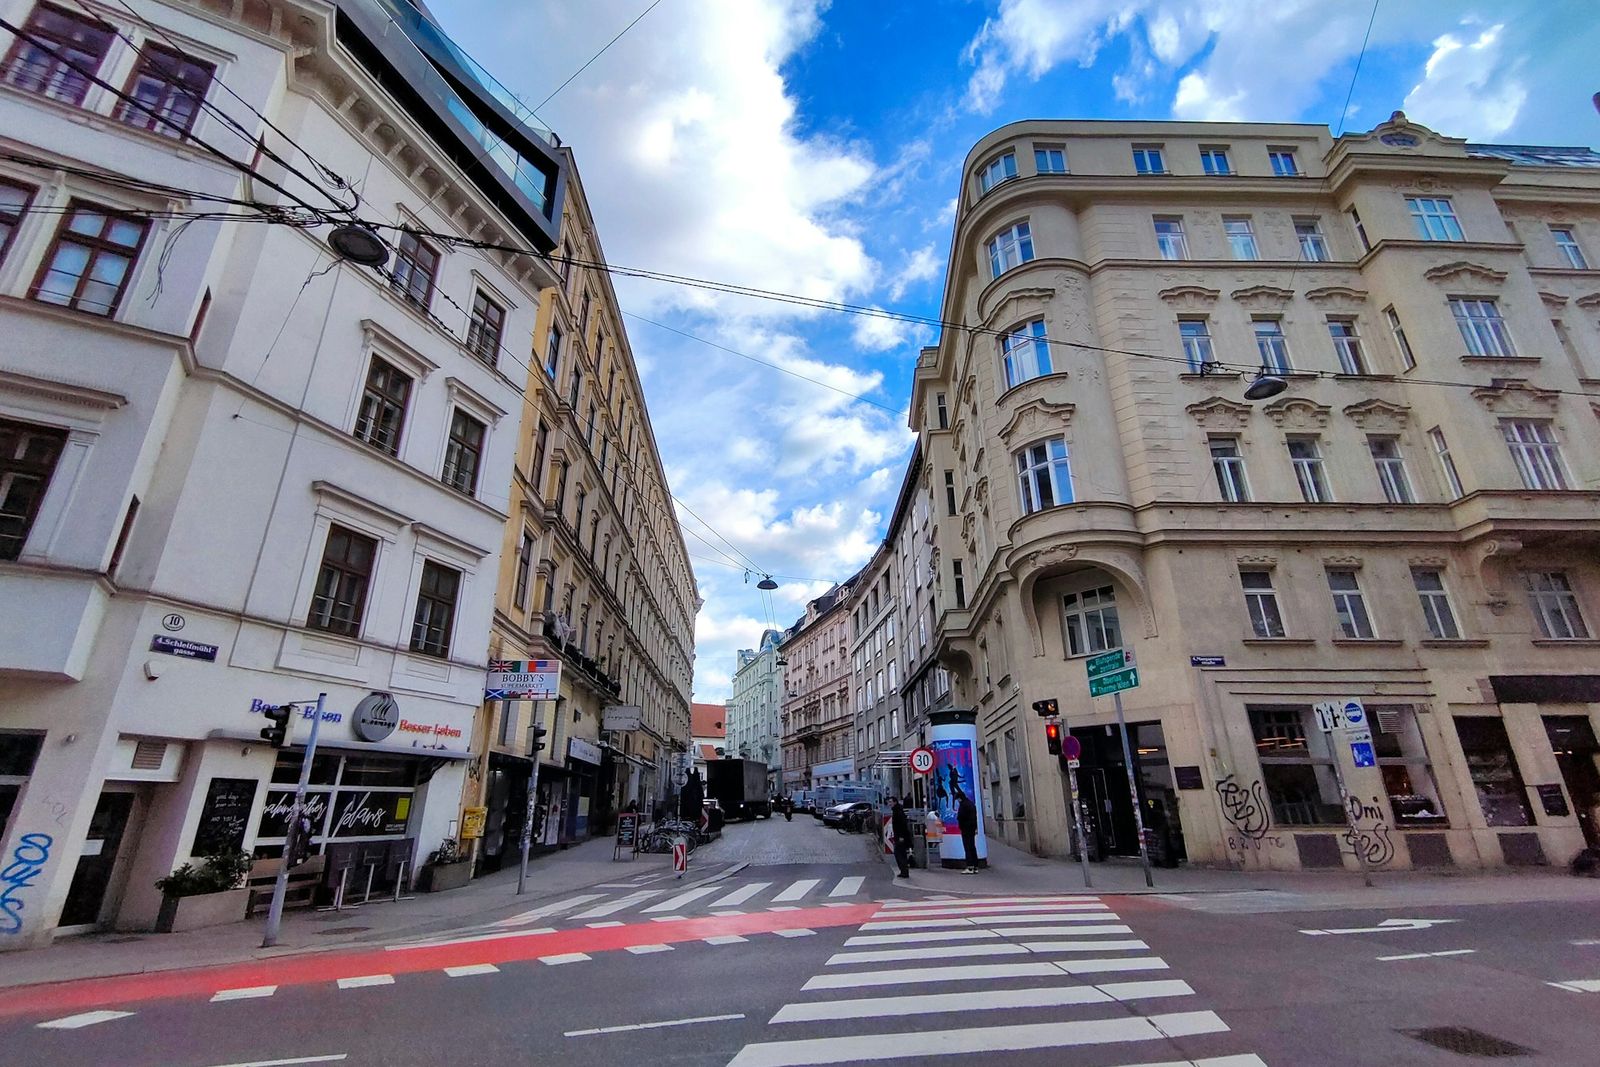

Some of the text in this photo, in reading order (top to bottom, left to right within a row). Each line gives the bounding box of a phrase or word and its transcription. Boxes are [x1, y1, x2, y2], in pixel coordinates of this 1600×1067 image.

[169, 616, 181, 626] 10
[173, 648, 196, 656] gasse
[502, 674, 545, 682] BOBBY'S
[916, 754, 930, 767] 30
[332, 791, 387, 838] plans
